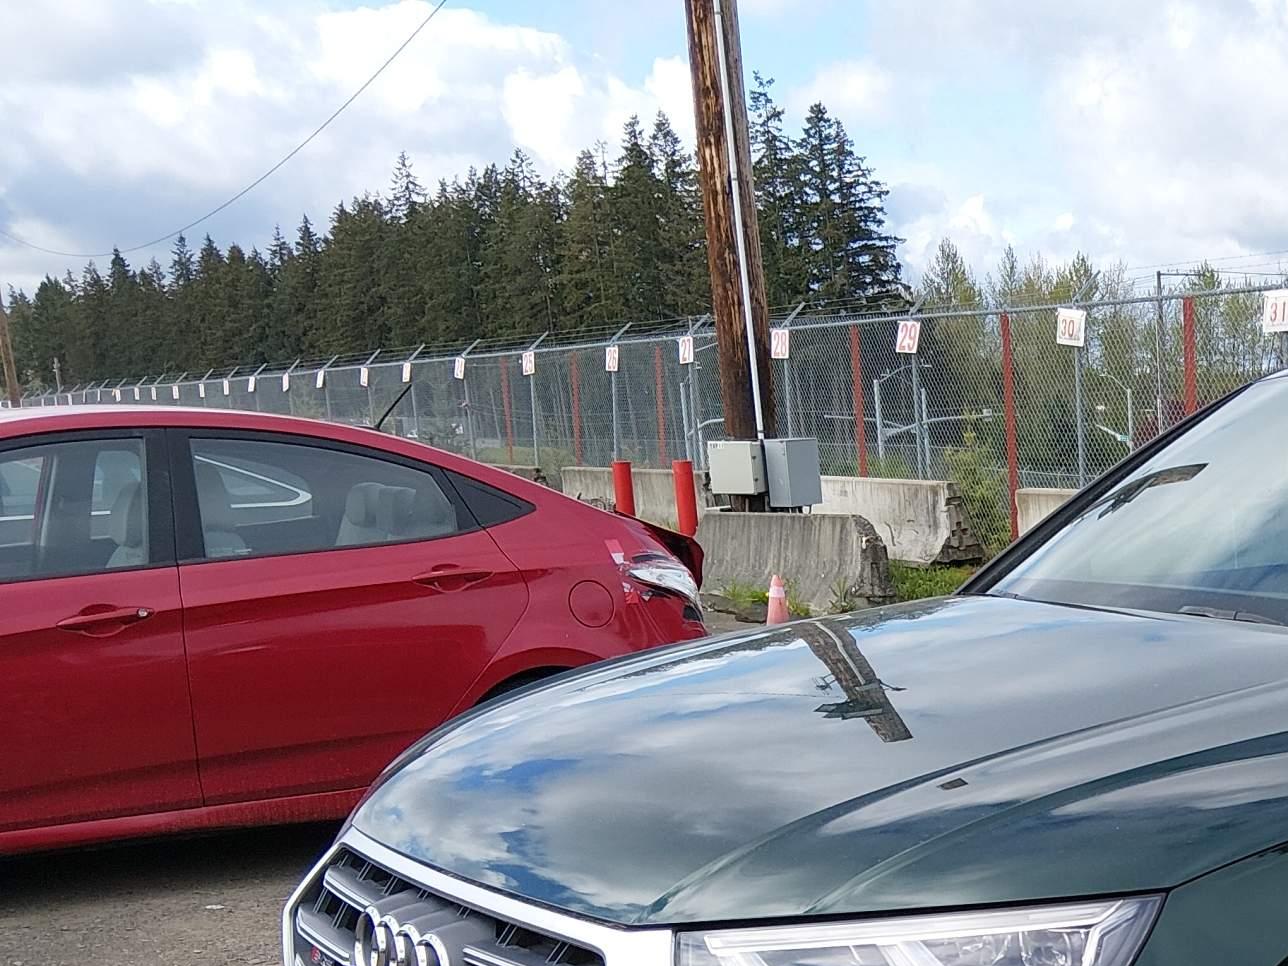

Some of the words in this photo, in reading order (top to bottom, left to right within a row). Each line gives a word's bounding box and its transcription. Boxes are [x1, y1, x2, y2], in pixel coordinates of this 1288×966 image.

[1270, 301, 1287, 322] 31
[898, 322, 918, 352] 29
[1060, 318, 1076, 338] 30
[681, 337, 692, 362] 27
[773, 331, 788, 357] 28
[523, 354, 534, 373] 25
[607, 348, 617, 370] 26
